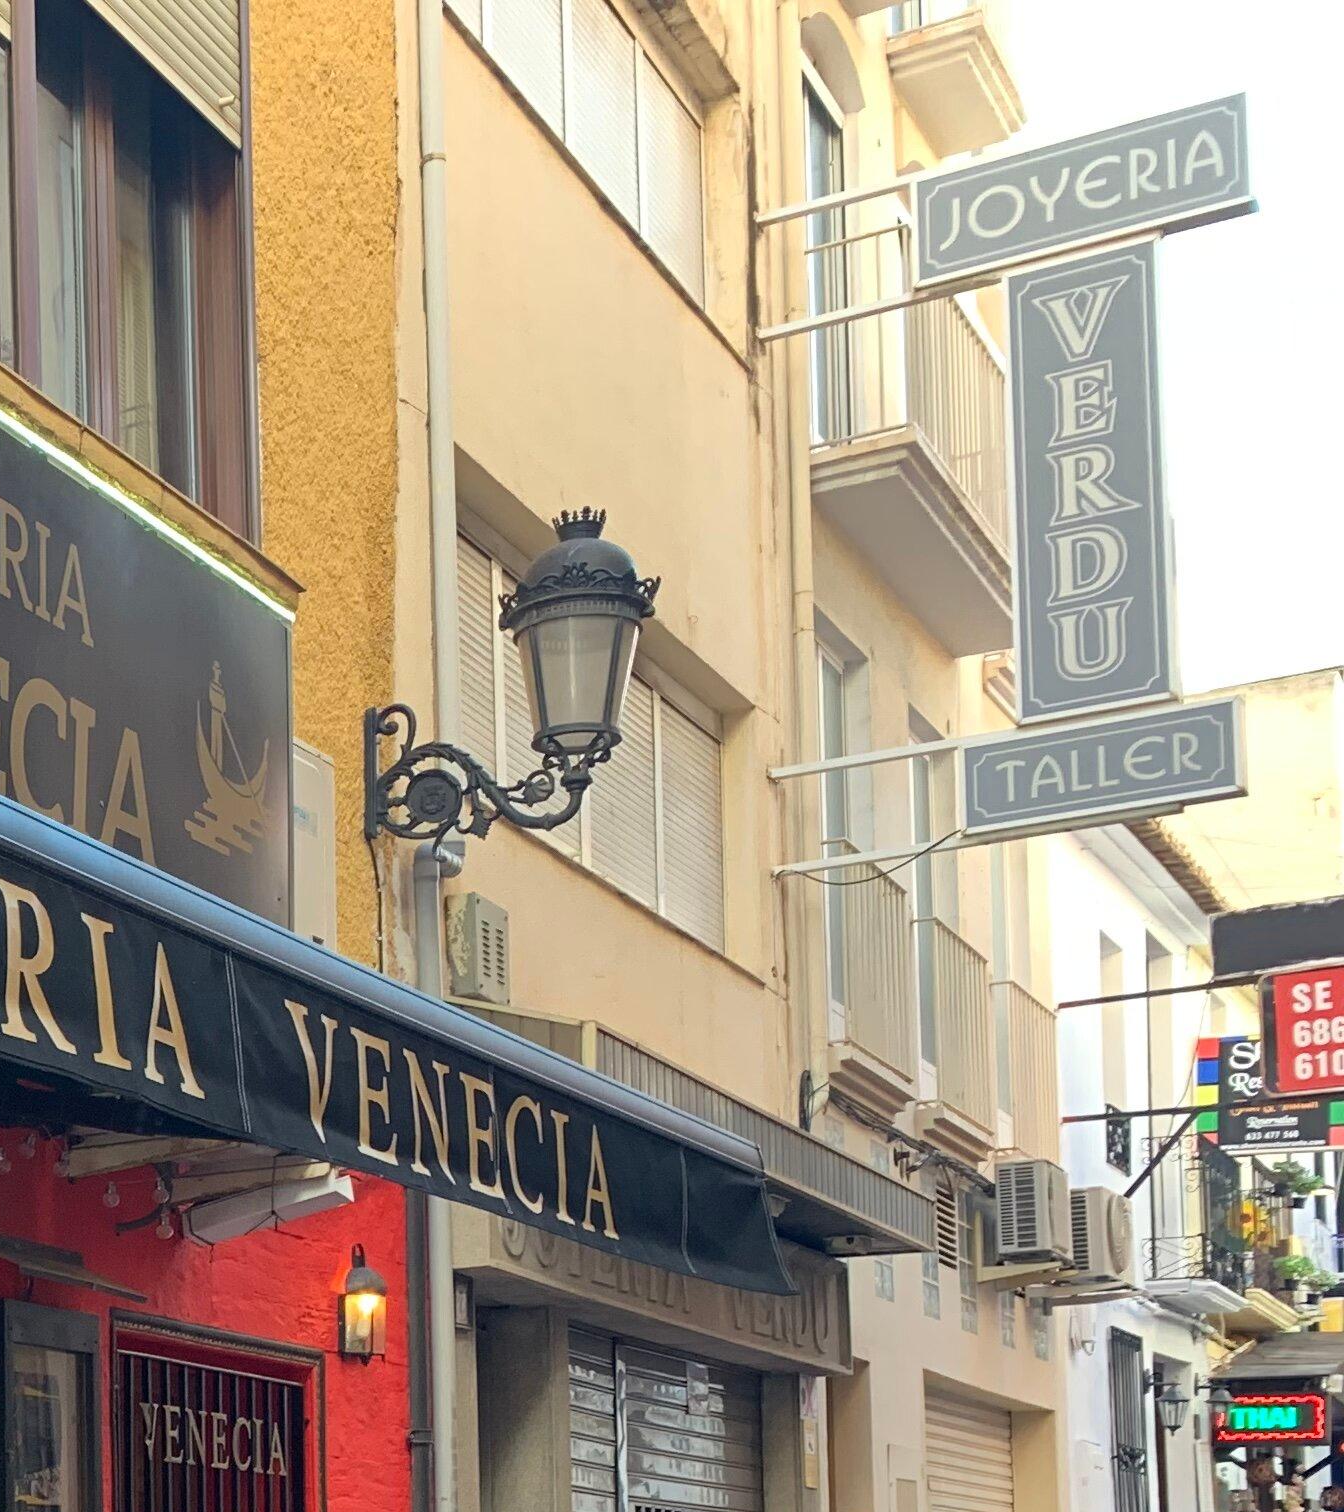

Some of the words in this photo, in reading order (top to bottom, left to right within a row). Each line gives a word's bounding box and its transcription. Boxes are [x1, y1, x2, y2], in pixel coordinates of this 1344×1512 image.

[939, 130, 1227, 253] JOYERIA
[1031, 275, 1143, 682] VERDU
[996, 732, 1204, 801] TALLER
[1292, 980, 1334, 1013] SE
[284, 998, 620, 1242] VENECIA
[139, 1400, 288, 1477] VENECIA
[1230, 1406, 1299, 1430] THAI
